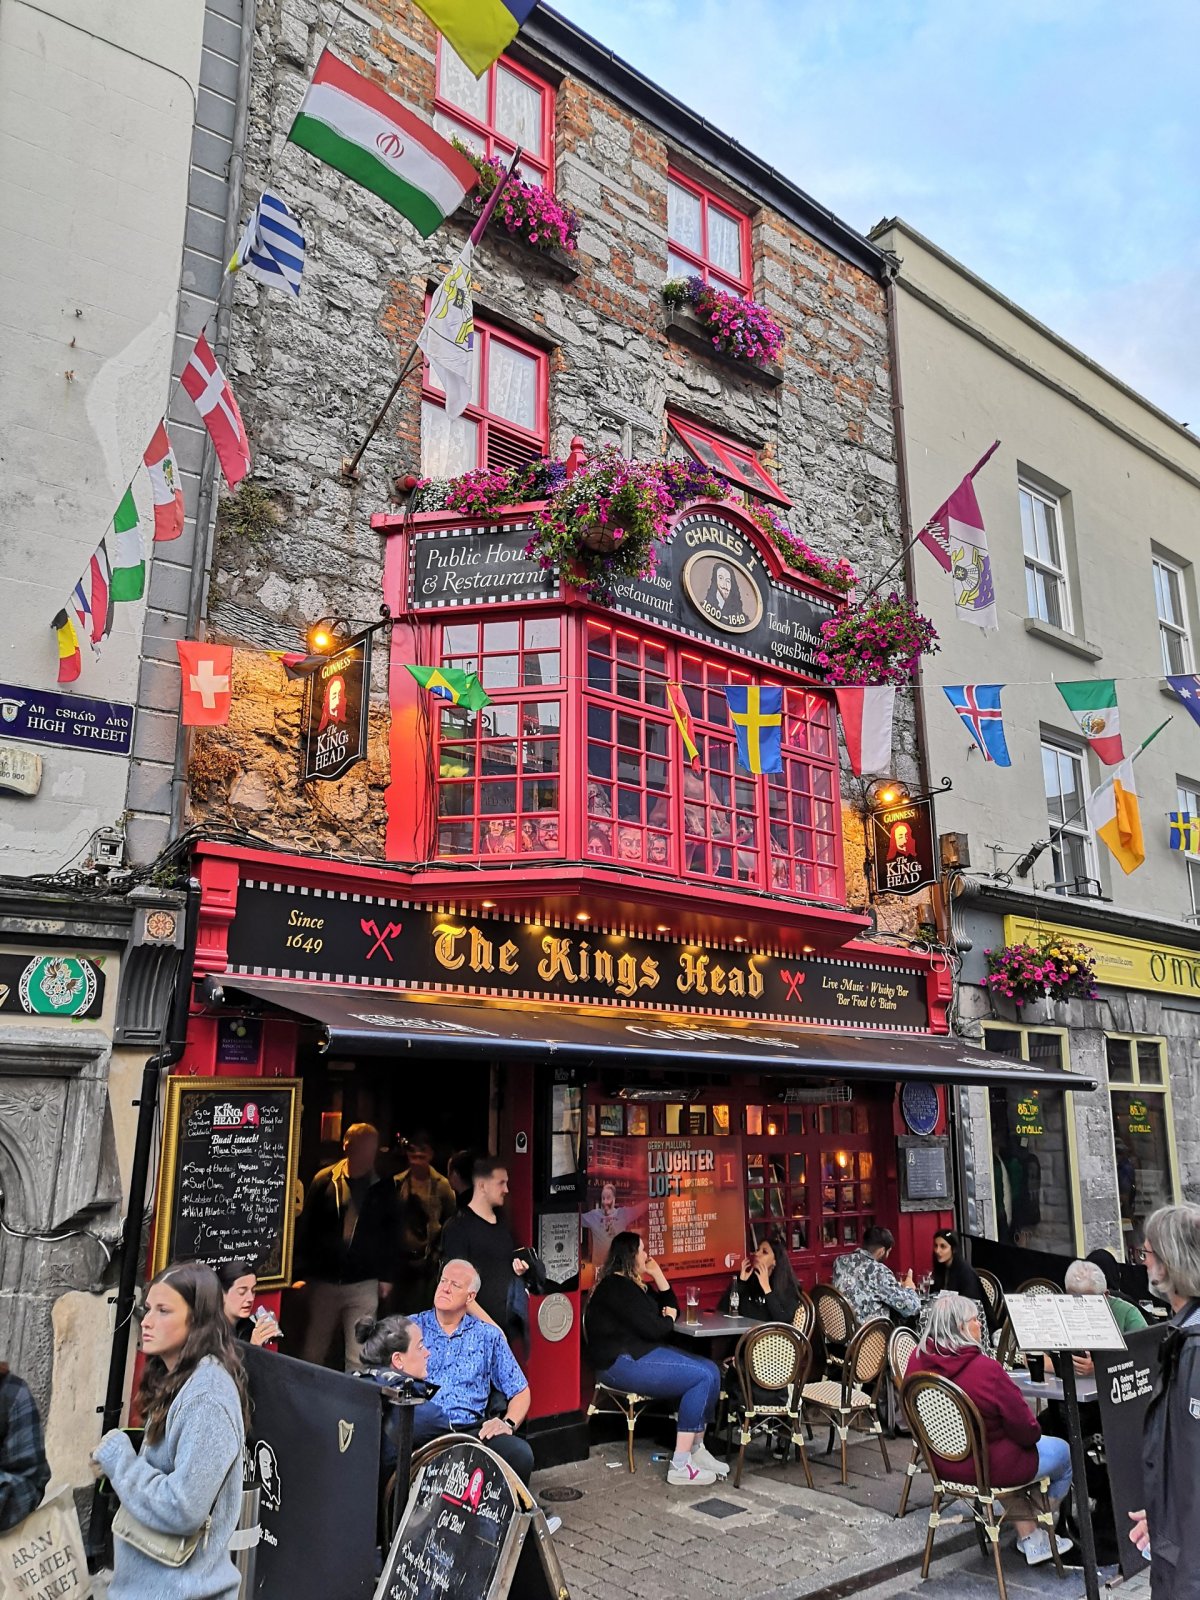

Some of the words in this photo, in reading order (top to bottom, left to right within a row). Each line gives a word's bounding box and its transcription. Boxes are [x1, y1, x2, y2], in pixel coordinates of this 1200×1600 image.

[426, 547, 481, 569] Public
[485, 544, 542, 563] Houe
[685, 527, 744, 557] CHARLES
[747, 556, 758, 572] I
[422, 575, 438, 594] &
[442, 568, 547, 594] Restaurant
[642, 574, 672, 590] ouse
[609, 573, 674, 614] Restaurant
[767, 612, 790, 635] Teach
[322, 656, 351, 679] GUINNESS
[27, 716, 66, 733] HIGH
[73, 724, 127, 742] STREET
[316, 746, 346, 770] HEAD
[884, 809, 915, 823] GUINNESS
[887, 872, 919, 887] HEAD
[288, 910, 325, 929] Since
[286, 934, 323, 954] 1649
[432, 924, 520, 974] The
[538, 936, 660, 997] Kings
[677, 952, 764, 999] Head
[822, 976, 838, 989] Live
[841, 979, 864, 992] Music
[870, 982, 895, 999] Whiskey
[896, 985, 909, 996] Bar
[837, 994, 850, 1005] Bar
[852, 995, 867, 1007] Food
[870, 997, 876, 1008] &
[879, 998, 897, 1010] Bistro
[213, 1116, 240, 1125] HEAD
[212, 1135, 232, 1144] Buail
[648, 1141, 665, 1150] GERRY
[666, 1140, 691, 1149] MALLON'S
[189, 1162, 205, 1174] Soup
[206, 1165, 212, 1175] of
[648, 1150, 714, 1173] LAUGHTER
[190, 1177, 206, 1190] Surf
[648, 1175, 682, 1197] LOFT
[684, 1178, 708, 1188] UPSTAIRS
[649, 1248, 657, 1256] SUN
[1107, 1366, 1117, 1374] PROUD
[1122, 1361, 1134, 1370] SUPPORT
[1120, 1374, 1134, 1383] Galway
[1121, 1382, 1131, 1392] 2020
[444, 1480, 464, 1498] HEAD
[14, 1545, 76, 1591] WEATER
[28, 1568, 79, 1600] ARKET
